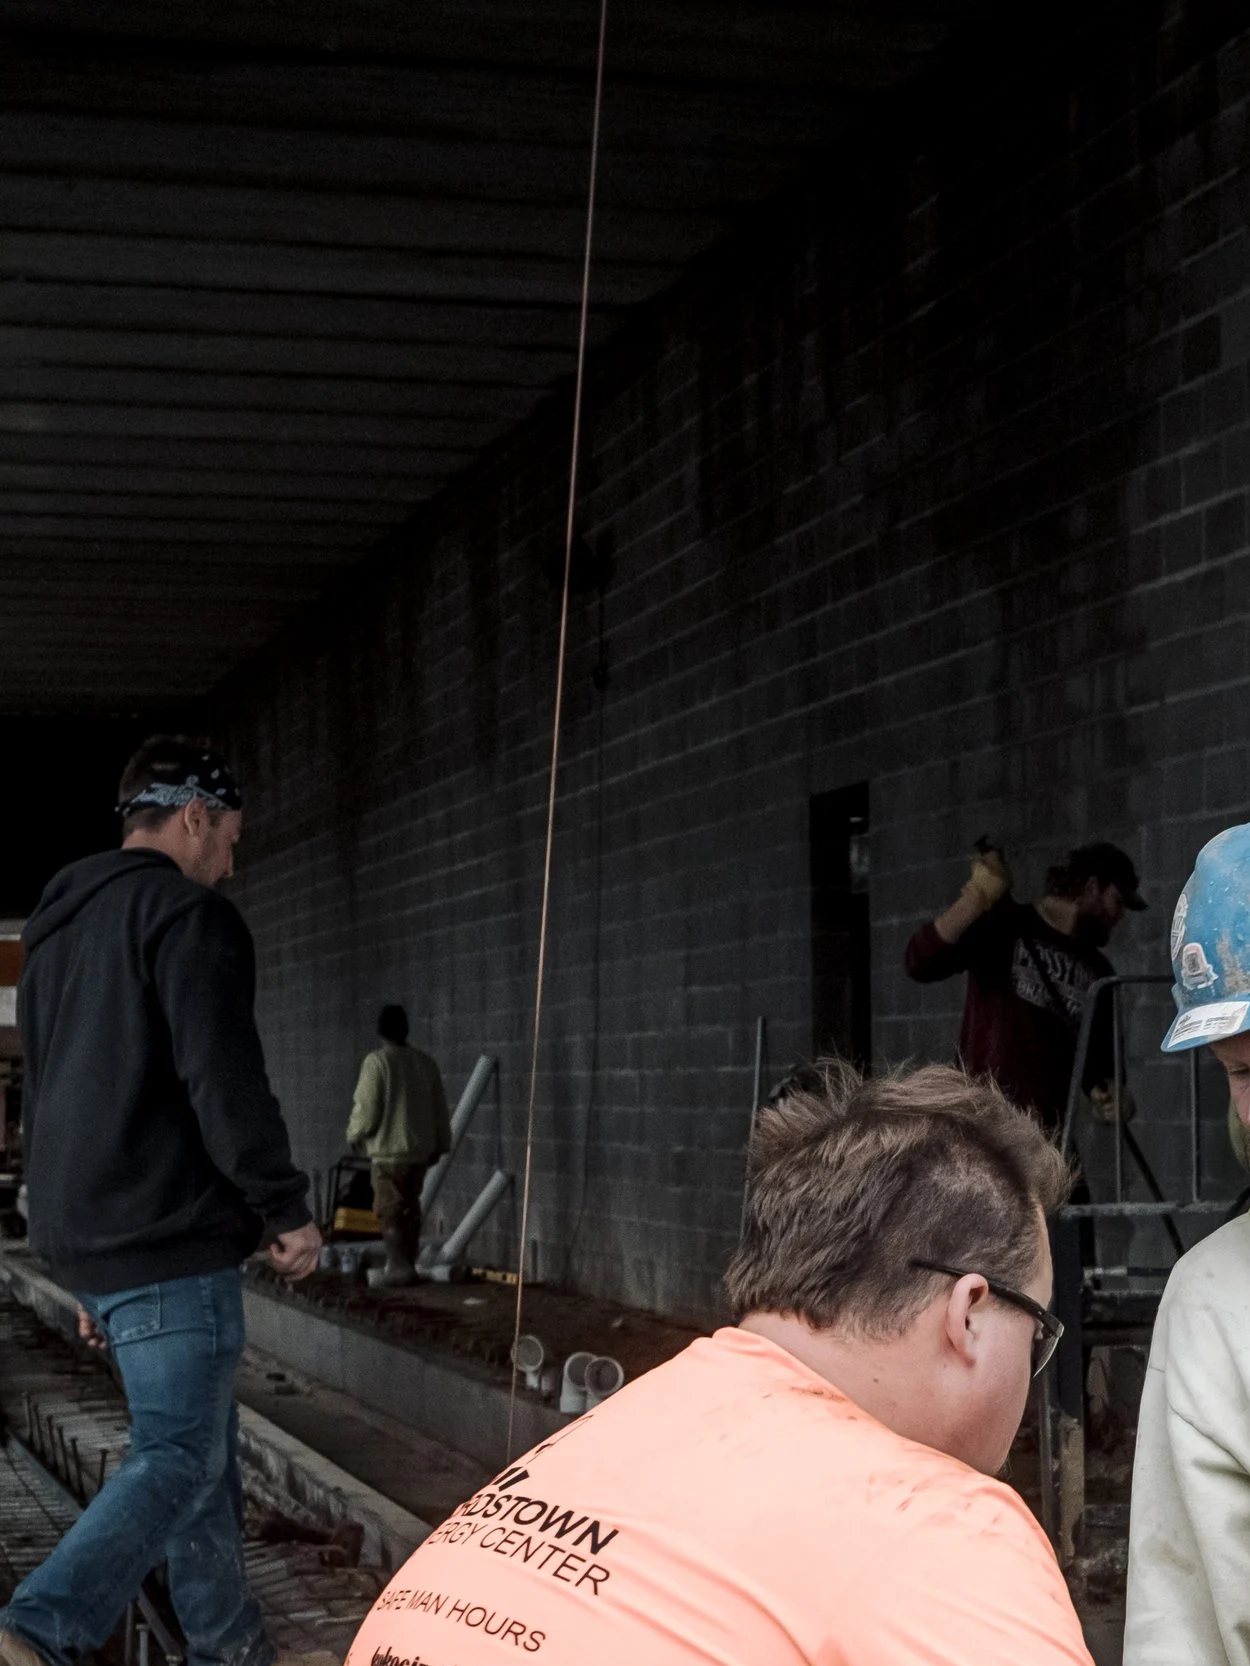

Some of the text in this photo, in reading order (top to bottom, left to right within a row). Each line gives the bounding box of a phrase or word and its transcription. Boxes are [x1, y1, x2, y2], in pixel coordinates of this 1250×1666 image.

[427, 1521, 610, 1596] ERGY CENTER
[376, 1589, 546, 1653] SAFE MAN HOURS
